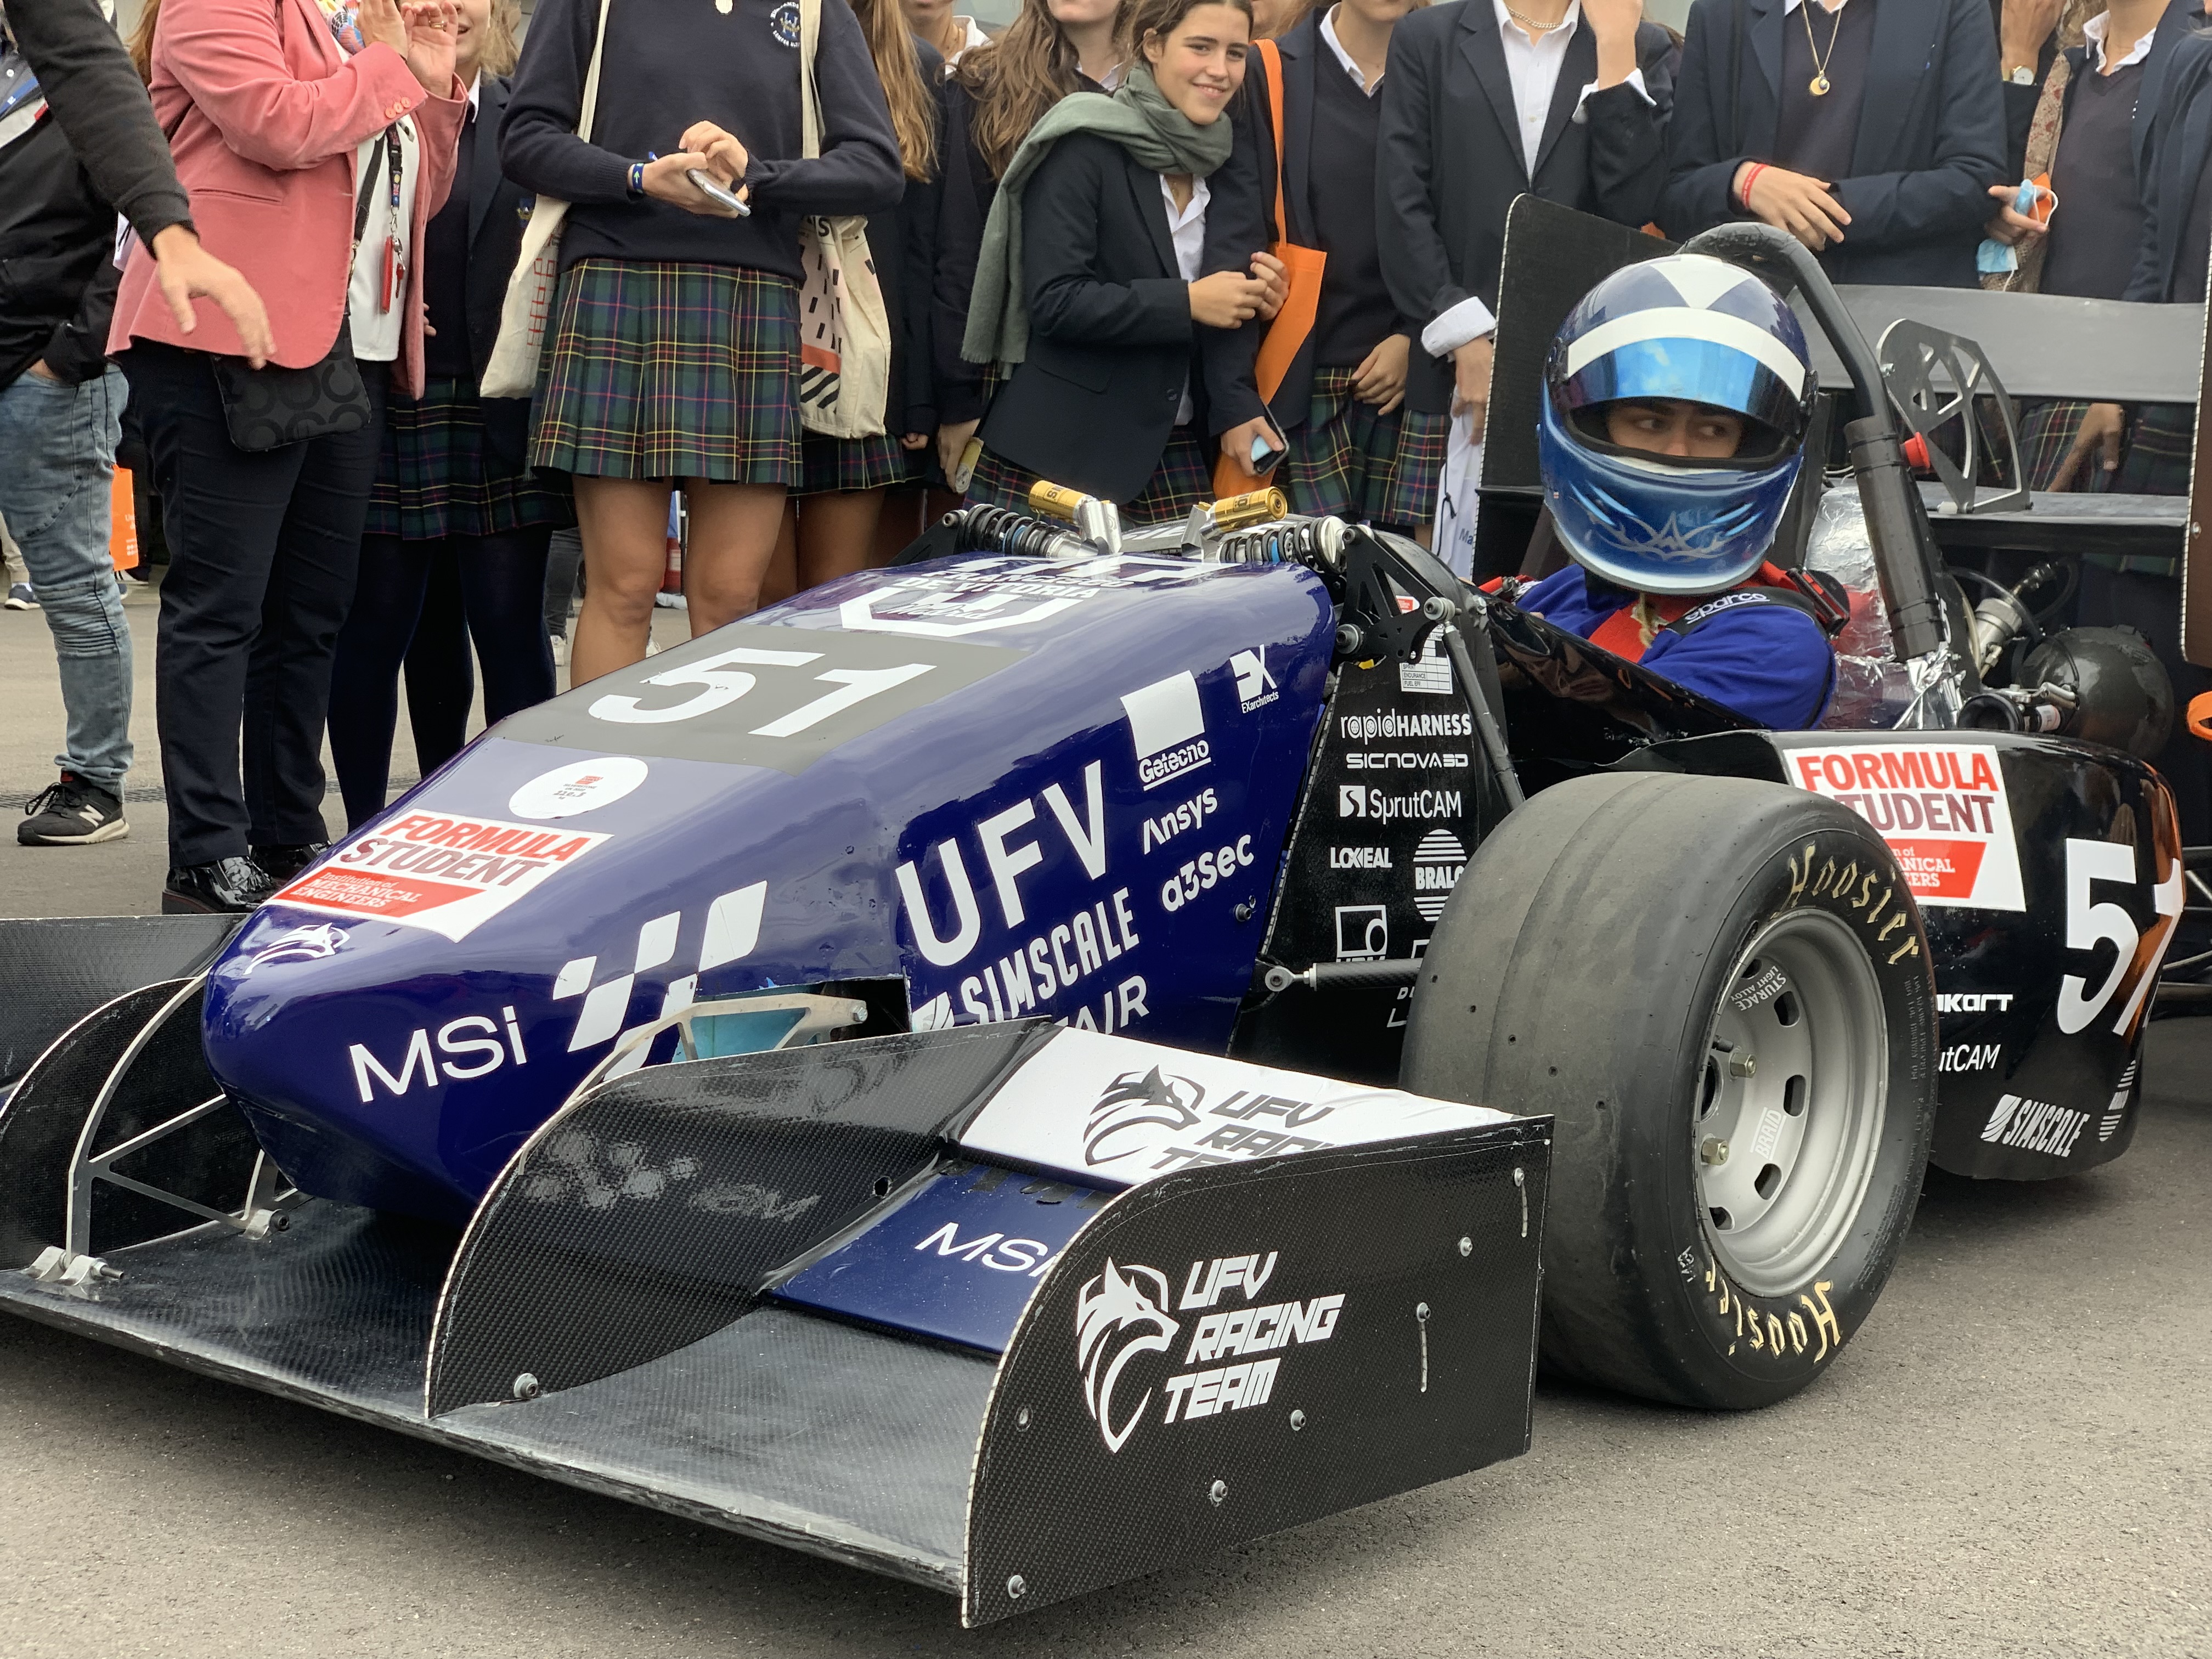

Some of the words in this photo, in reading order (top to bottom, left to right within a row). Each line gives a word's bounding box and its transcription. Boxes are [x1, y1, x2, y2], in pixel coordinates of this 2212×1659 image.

[900, 577, 952, 590] DE
[956, 582, 1099, 599] VITORIA
[921, 571, 1135, 587] FRANCISCO
[588, 647, 937, 737] 51
[1241, 691, 1279, 713] EXarchitects
[1340, 708, 1472, 744] rapidHARNESS
[1139, 740, 1209, 783] Getecno
[1796, 751, 1999, 792] FORMULA
[1144, 788, 1218, 855] Ansys
[1370, 789, 1462, 825] SprutCAM
[1834, 793, 1995, 833] TUDENT
[384, 815, 591, 862] FORMULA
[1330, 847, 1393, 869] LOXEAL
[320, 872, 381, 887] Institution
[340, 838, 550, 887] STUDENT
[895, 759, 1107, 967] UFV
[289, 887, 392, 909] ENGINEERS
[304, 878, 422, 903] MECHANICAL
[2057, 837, 2184, 1036] 51
[961, 887, 1141, 1026] SIMSCALE
[1730, 985, 1756, 1002] ALLOY
[1735, 973, 1787, 1011] STURACE
[1757, 965, 1779, 988] LIGHT
[1208, 1090, 1336, 1128] UFV
[1193, 1123, 1335, 1156] RAC
[1754, 1109, 1784, 1159] BRAID
[1178, 1251, 1279, 1311] UFV
[1184, 1293, 1346, 1366] RACING
[1164, 1358, 1282, 1424] TEAM
